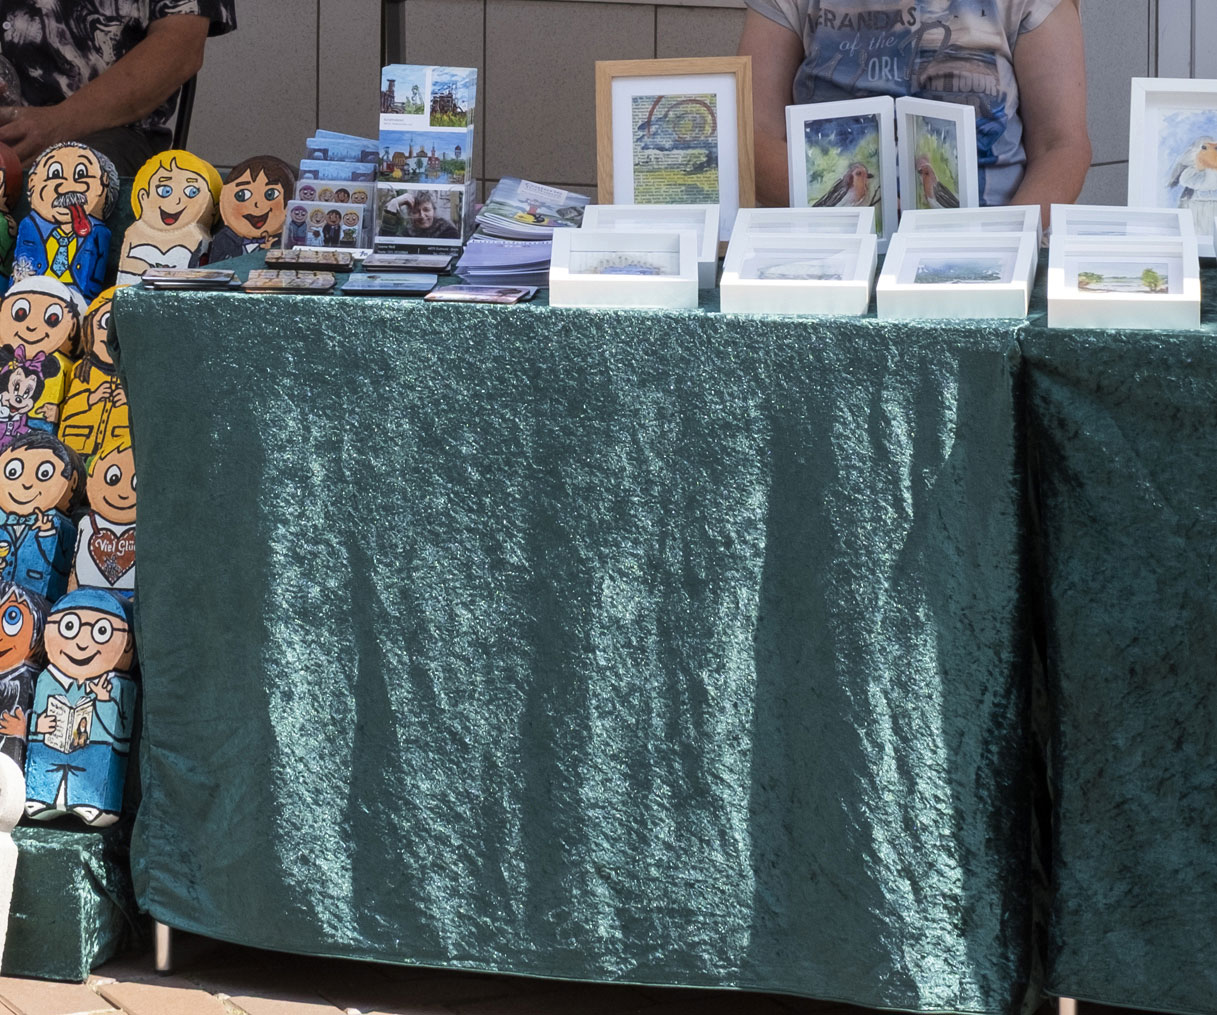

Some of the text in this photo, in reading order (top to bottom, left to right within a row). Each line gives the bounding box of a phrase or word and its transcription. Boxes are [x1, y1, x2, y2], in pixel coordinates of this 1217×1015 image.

[839, 31, 897, 57] of the
[95, 539, 136, 557] Viel Glü
